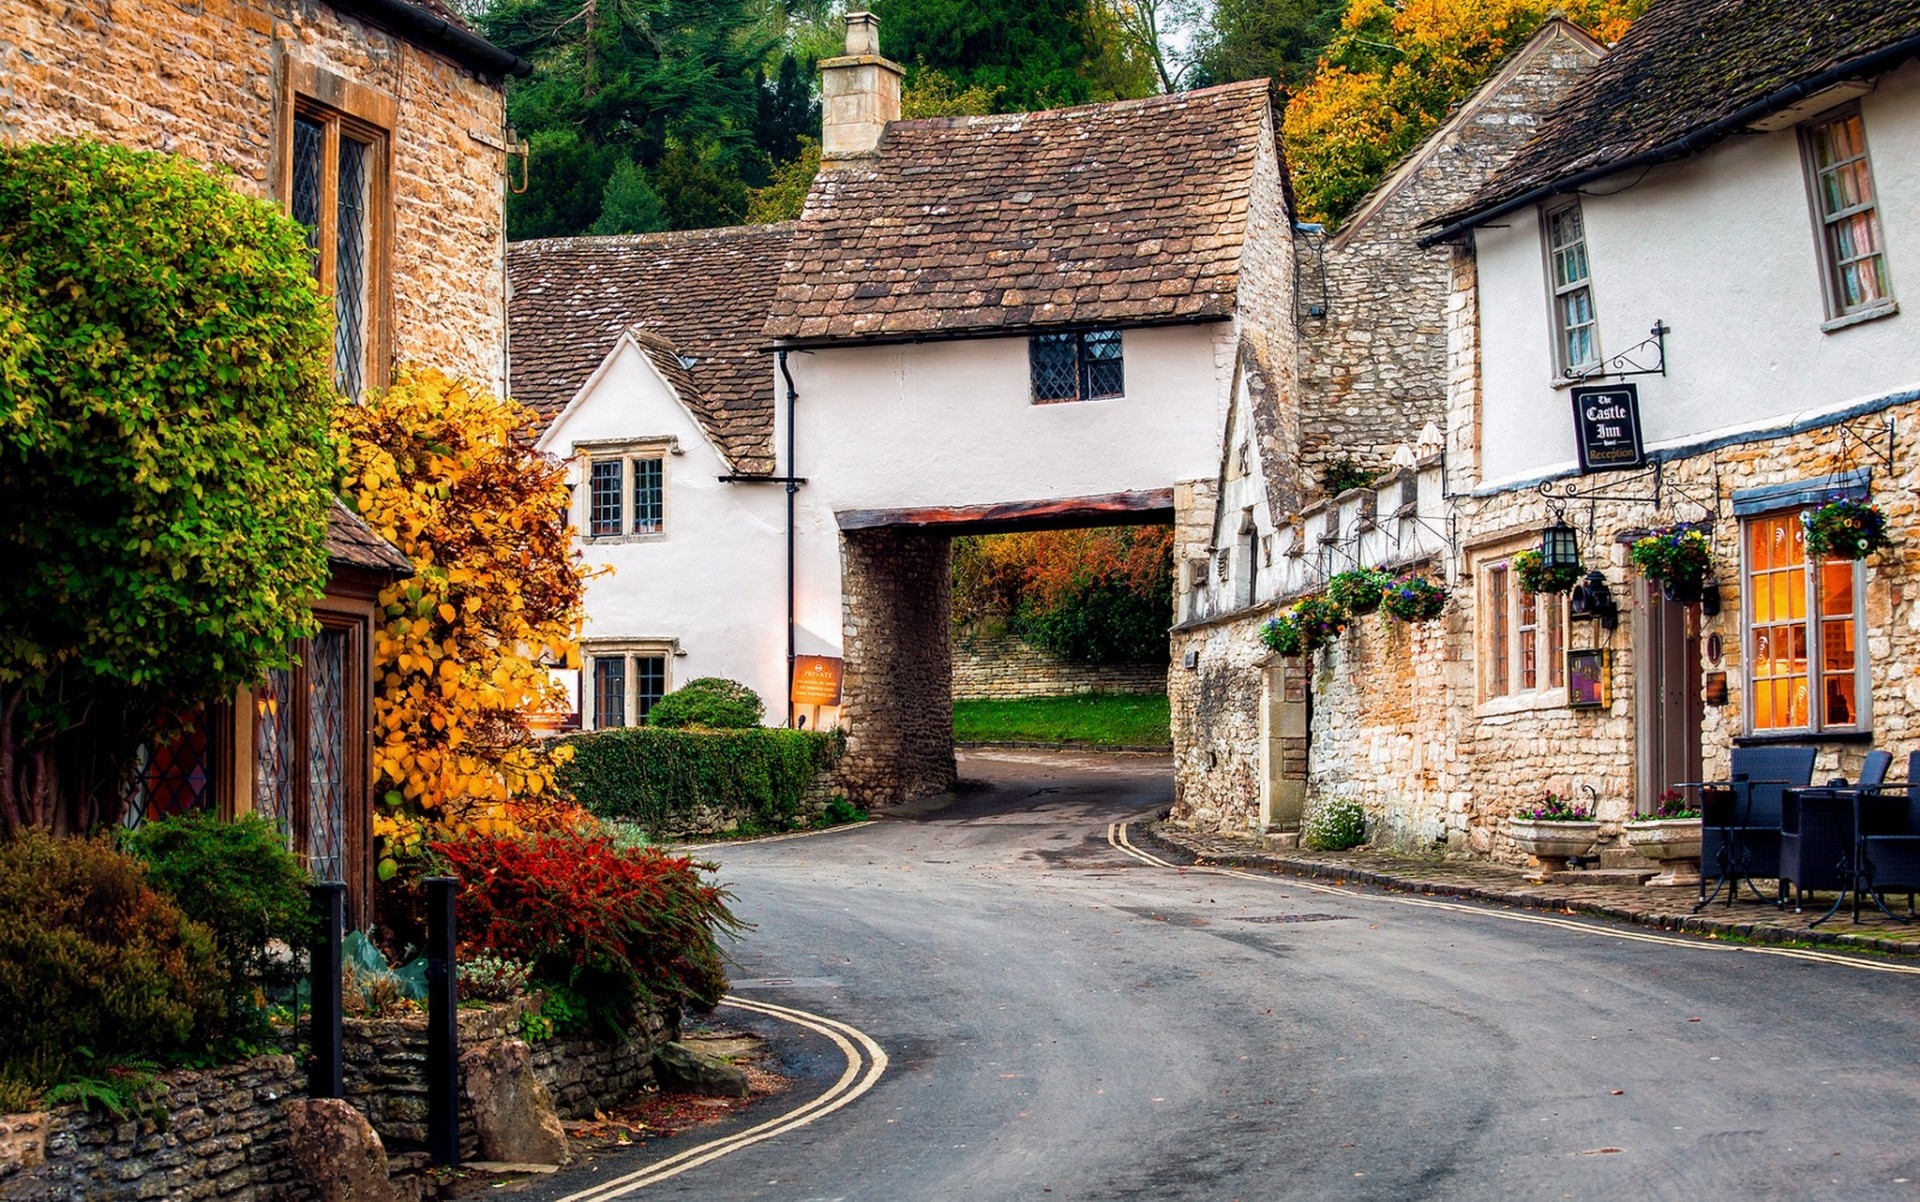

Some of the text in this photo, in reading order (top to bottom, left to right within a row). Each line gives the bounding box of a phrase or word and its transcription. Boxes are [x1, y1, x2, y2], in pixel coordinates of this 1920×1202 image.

[1598, 395, 1612, 405] The
[1586, 405, 1627, 421] Castle
[1596, 423, 1622, 439] Inn
[1589, 447, 1634, 461] Reception
[804, 670, 832, 679] PRIVATE
